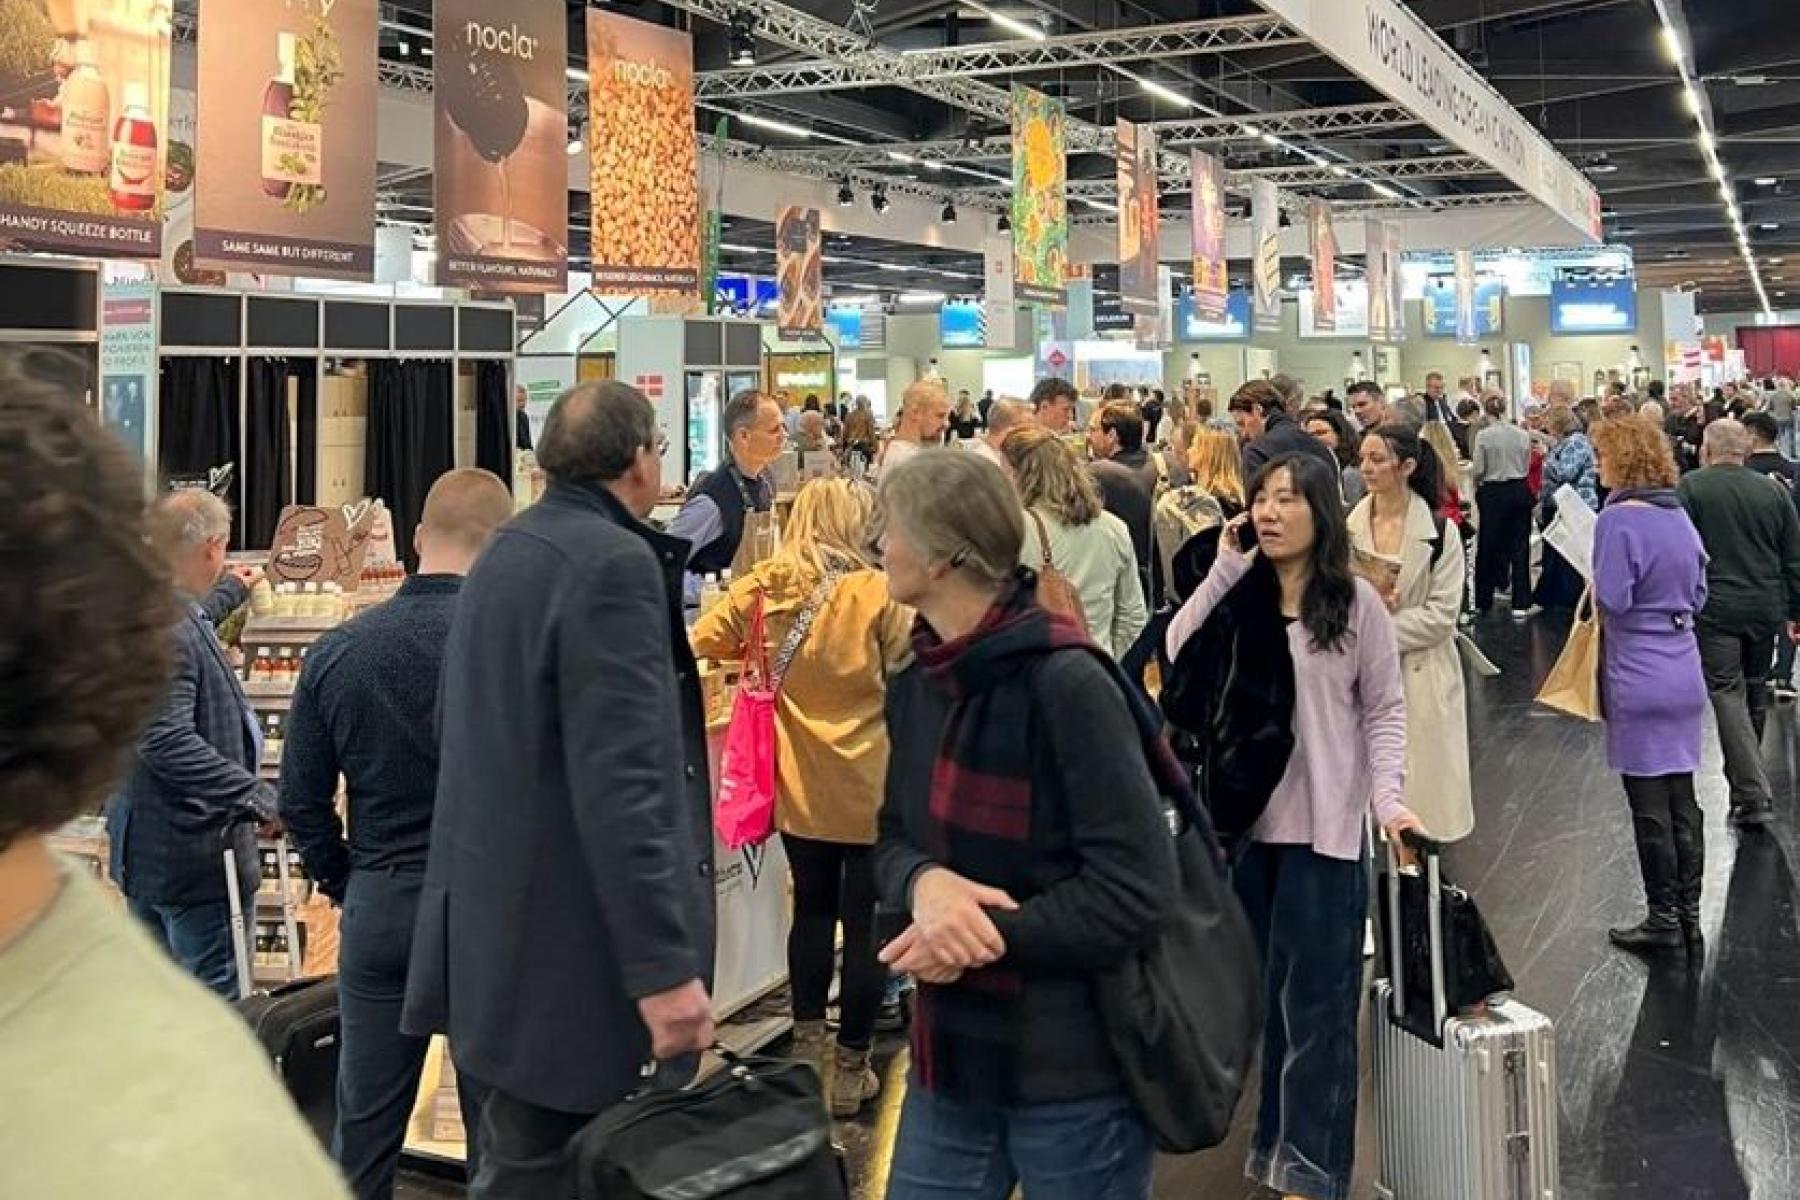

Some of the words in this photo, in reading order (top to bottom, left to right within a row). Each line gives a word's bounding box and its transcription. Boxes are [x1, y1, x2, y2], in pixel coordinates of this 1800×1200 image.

[0, 213, 48, 230] HANDY
[51, 219, 106, 238] SQUEEZE
[109, 225, 152, 243] BOTTLE
[223, 239, 251, 253] SAME
[253, 243, 279, 256] SAME
[281, 246, 300, 258] BUT
[302, 248, 353, 262] DIFFERENT
